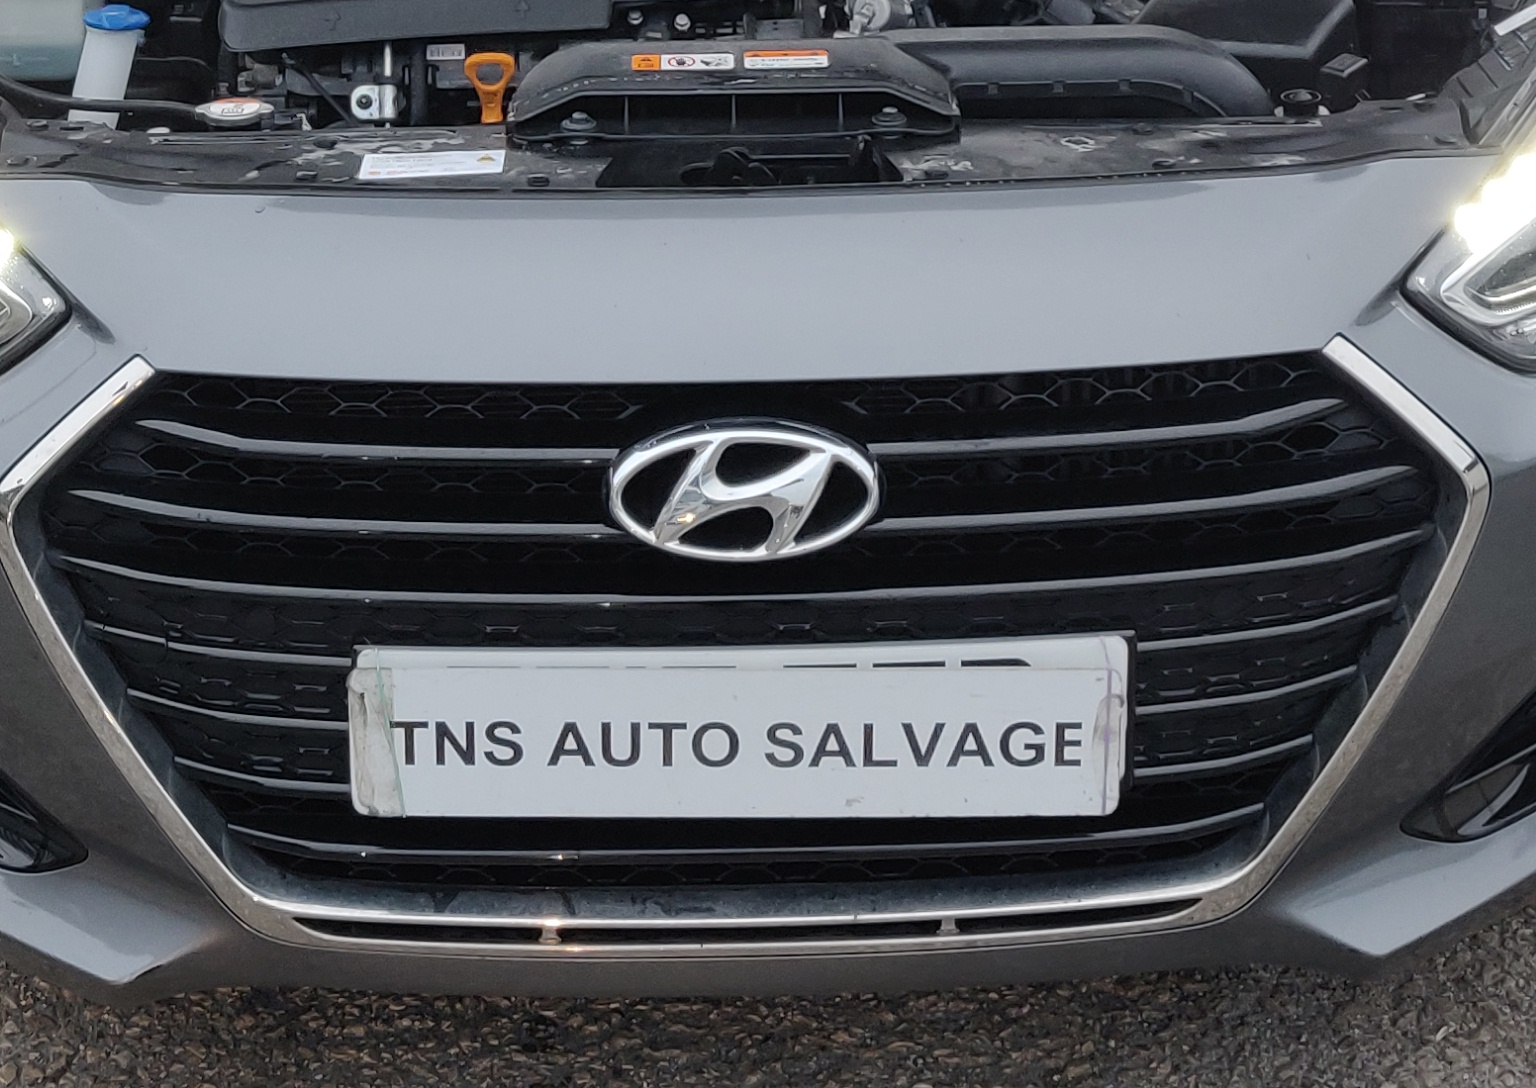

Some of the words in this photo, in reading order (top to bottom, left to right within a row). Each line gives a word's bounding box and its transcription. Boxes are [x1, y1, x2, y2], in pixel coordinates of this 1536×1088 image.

[390, 720, 524, 767] TNS
[546, 721, 740, 768] AUTO
[763, 721, 1083, 768] SALVAGE
